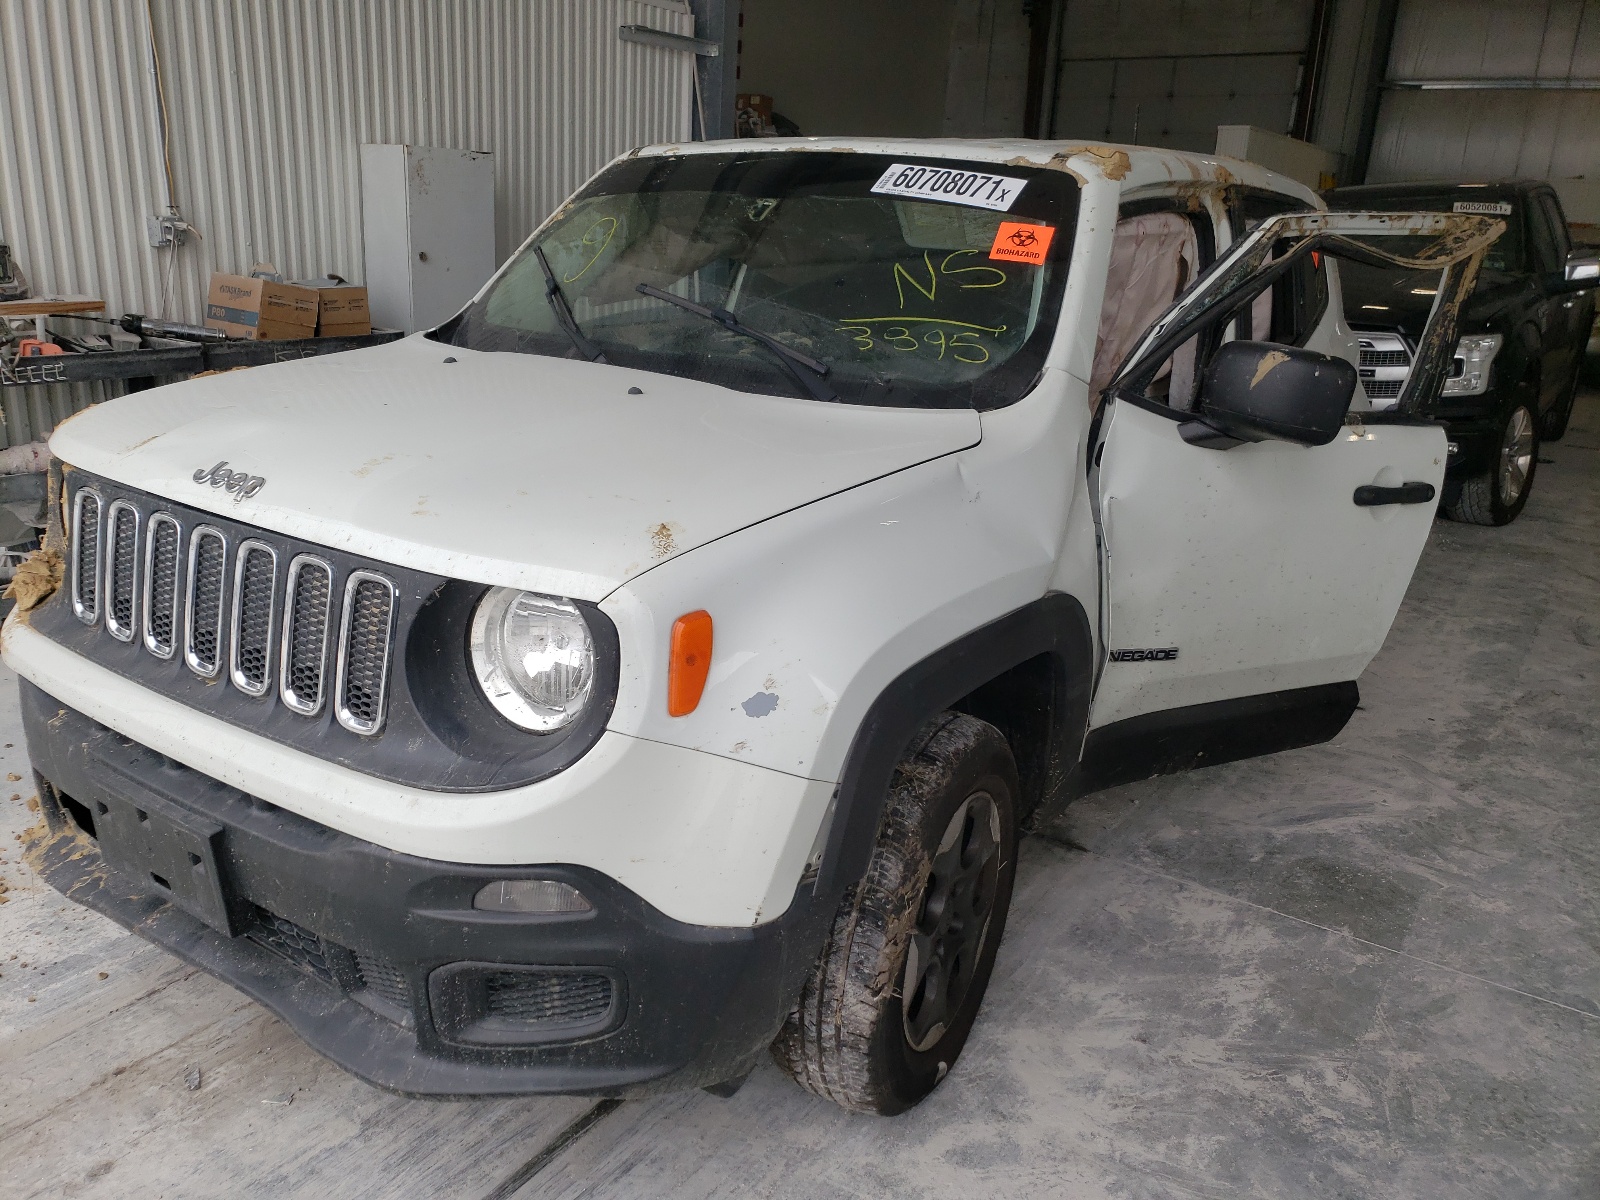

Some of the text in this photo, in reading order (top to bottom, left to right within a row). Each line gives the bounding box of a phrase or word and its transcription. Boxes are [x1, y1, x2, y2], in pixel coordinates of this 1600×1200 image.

[996, 247, 1040, 259] BIOHAZARD
[211, 306, 226, 318] P80
[193, 461, 266, 503] Jeep
